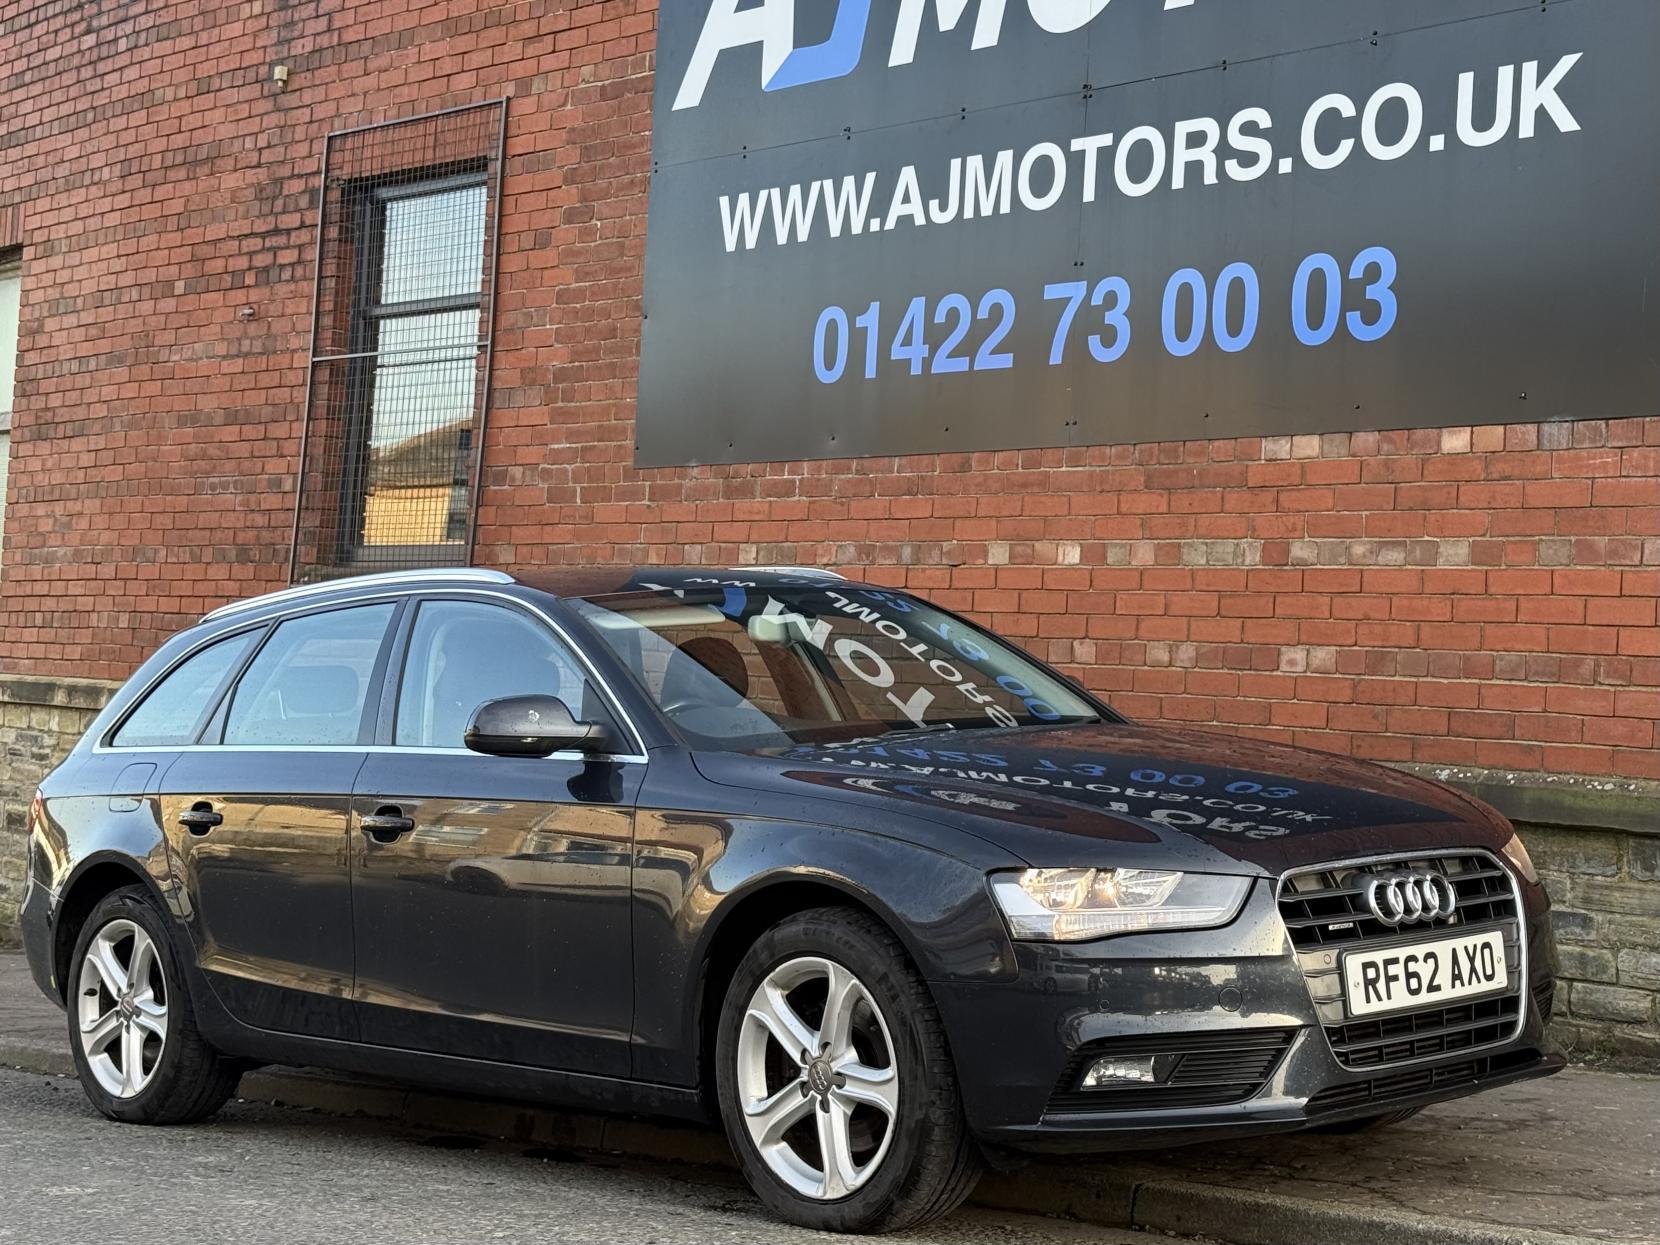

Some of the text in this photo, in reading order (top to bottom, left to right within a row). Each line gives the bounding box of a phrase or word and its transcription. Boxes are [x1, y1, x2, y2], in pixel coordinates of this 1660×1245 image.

[719, 52, 1584, 253] WWW.AJMOTORS.CO.UK
[813, 246, 1398, 384] 01422 73 00 03
[1361, 941, 1496, 1004] RF62 AXO
